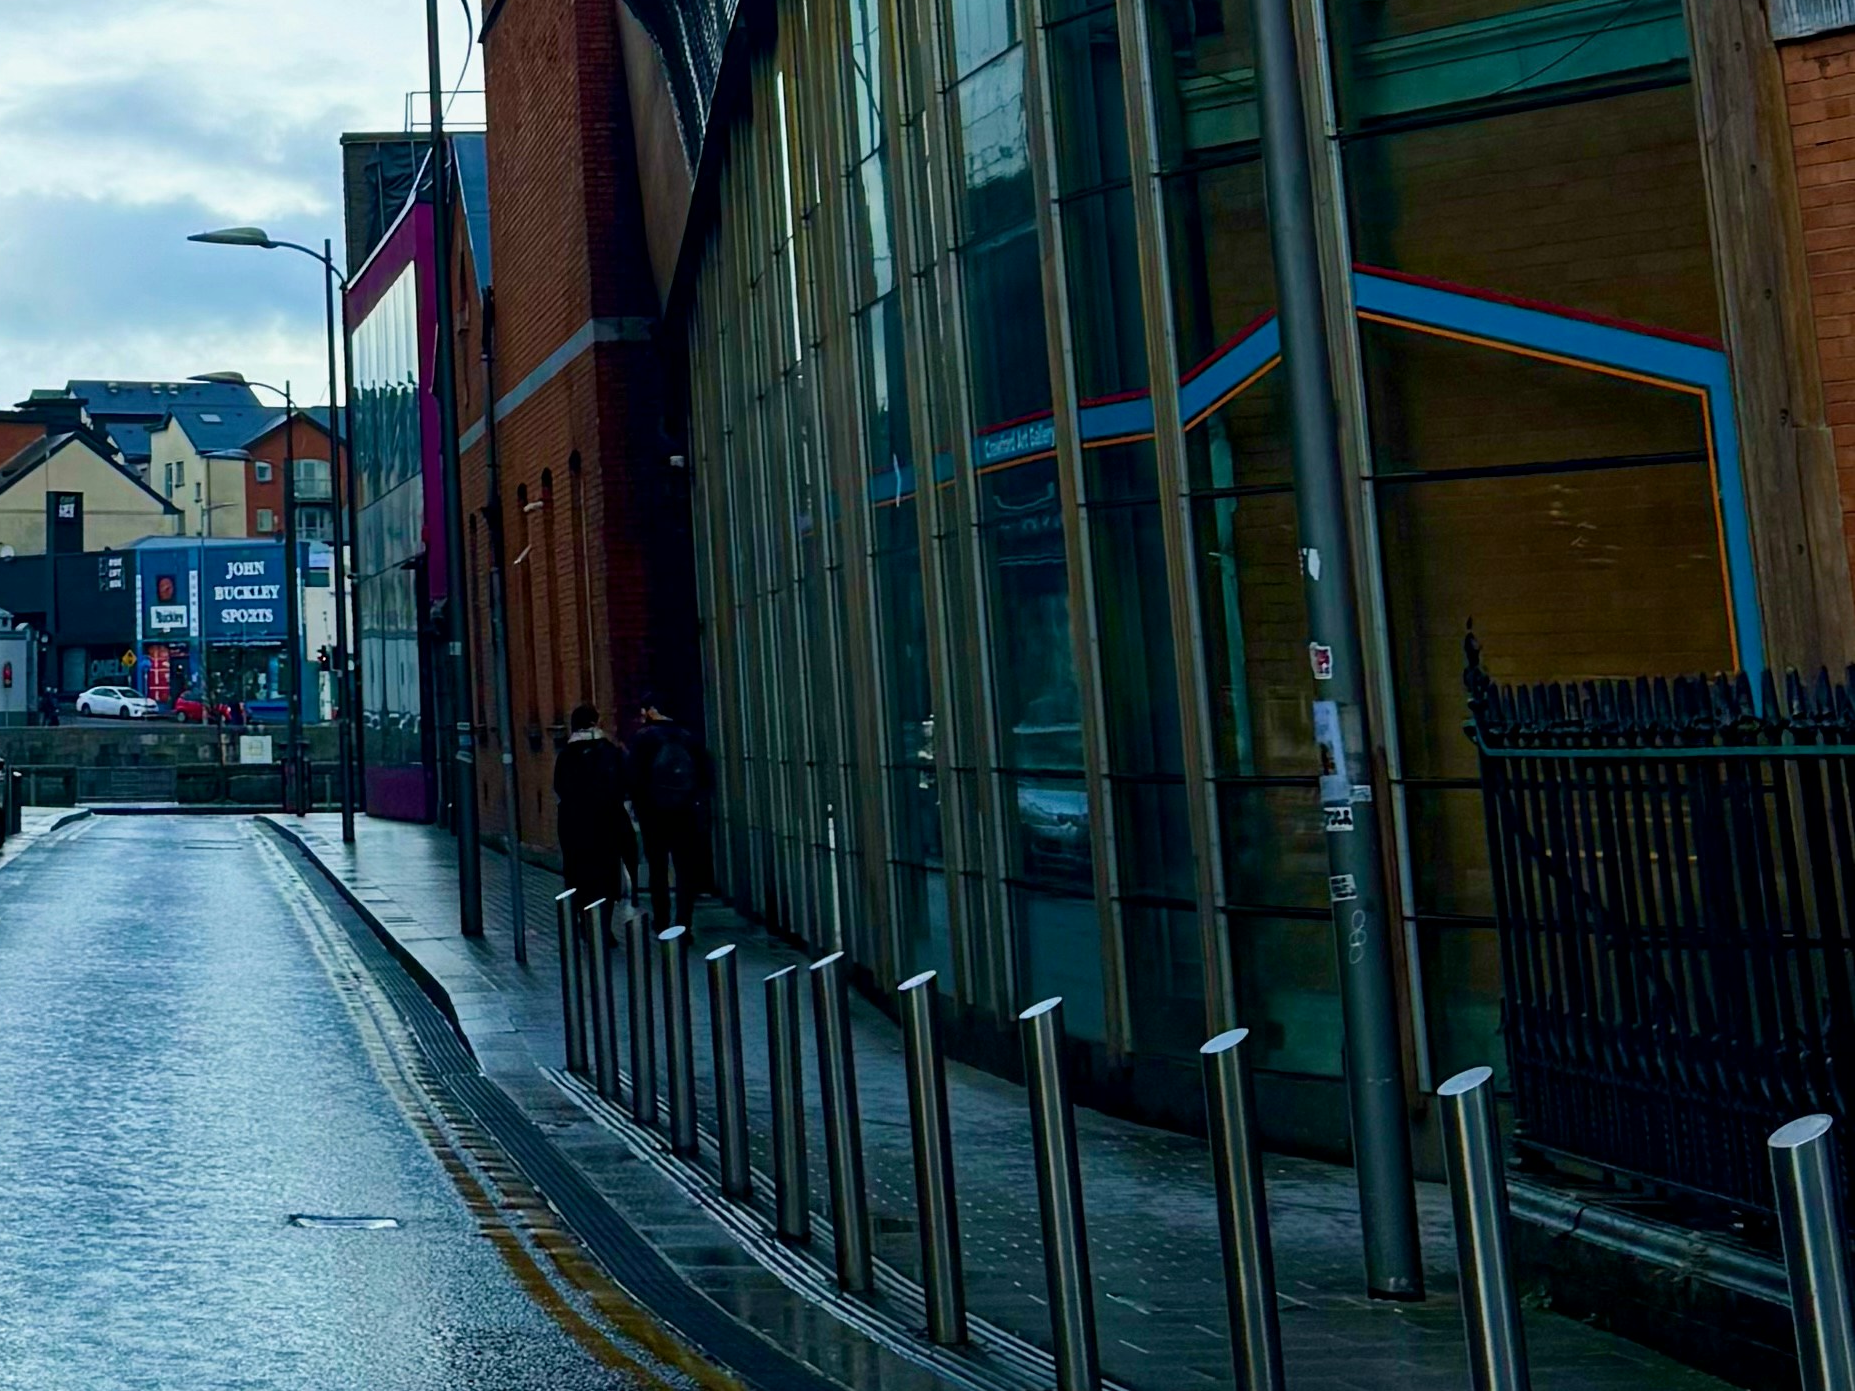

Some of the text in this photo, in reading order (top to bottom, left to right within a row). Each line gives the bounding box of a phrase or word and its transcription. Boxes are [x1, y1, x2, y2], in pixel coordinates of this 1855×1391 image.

[225, 561, 265, 580] JOHN
[214, 585, 281, 601] BUCKLEY
[221, 608, 274, 624] SPORTS
